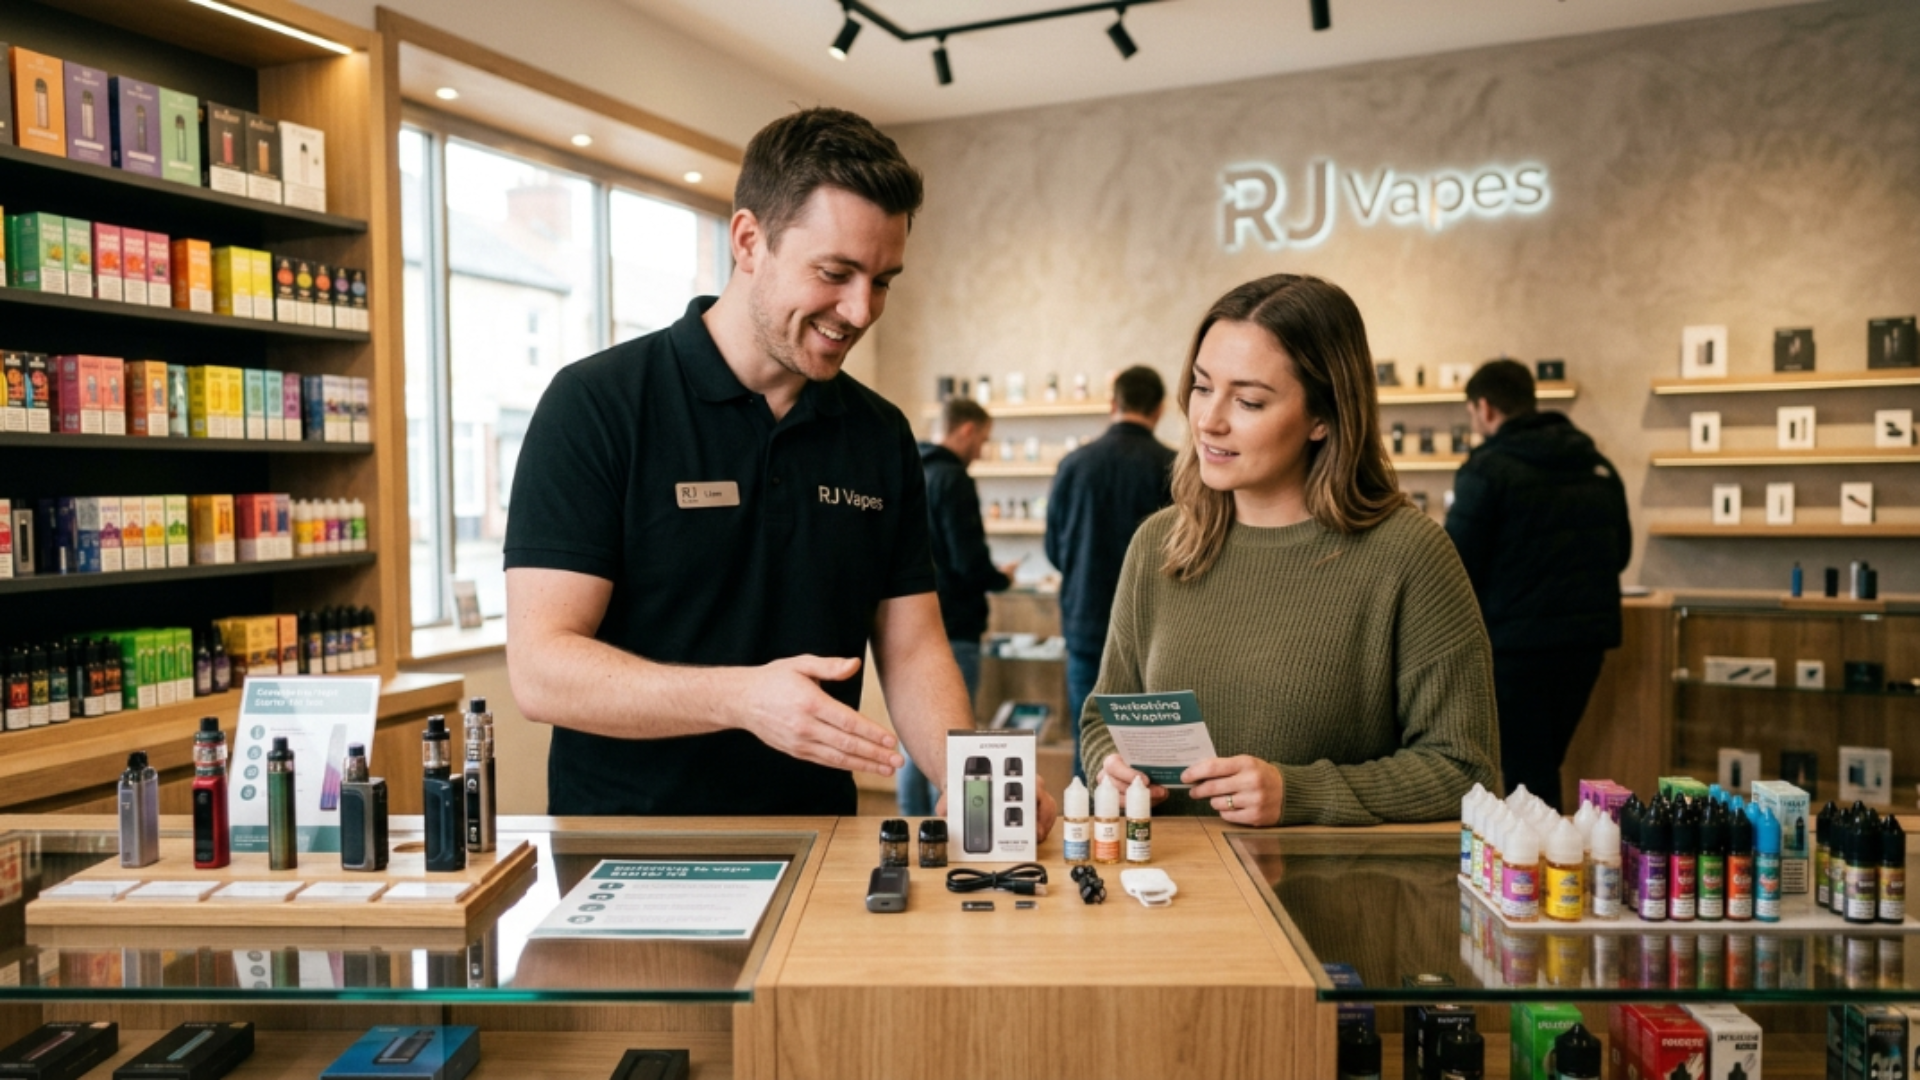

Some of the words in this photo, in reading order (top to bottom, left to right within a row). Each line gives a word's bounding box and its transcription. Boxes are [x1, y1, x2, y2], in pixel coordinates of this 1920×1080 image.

[1222, 160, 1334, 249] RJ
[1346, 165, 1547, 231] Vapes
[818, 484, 840, 504] RJ
[842, 488, 884, 511] Vapes
